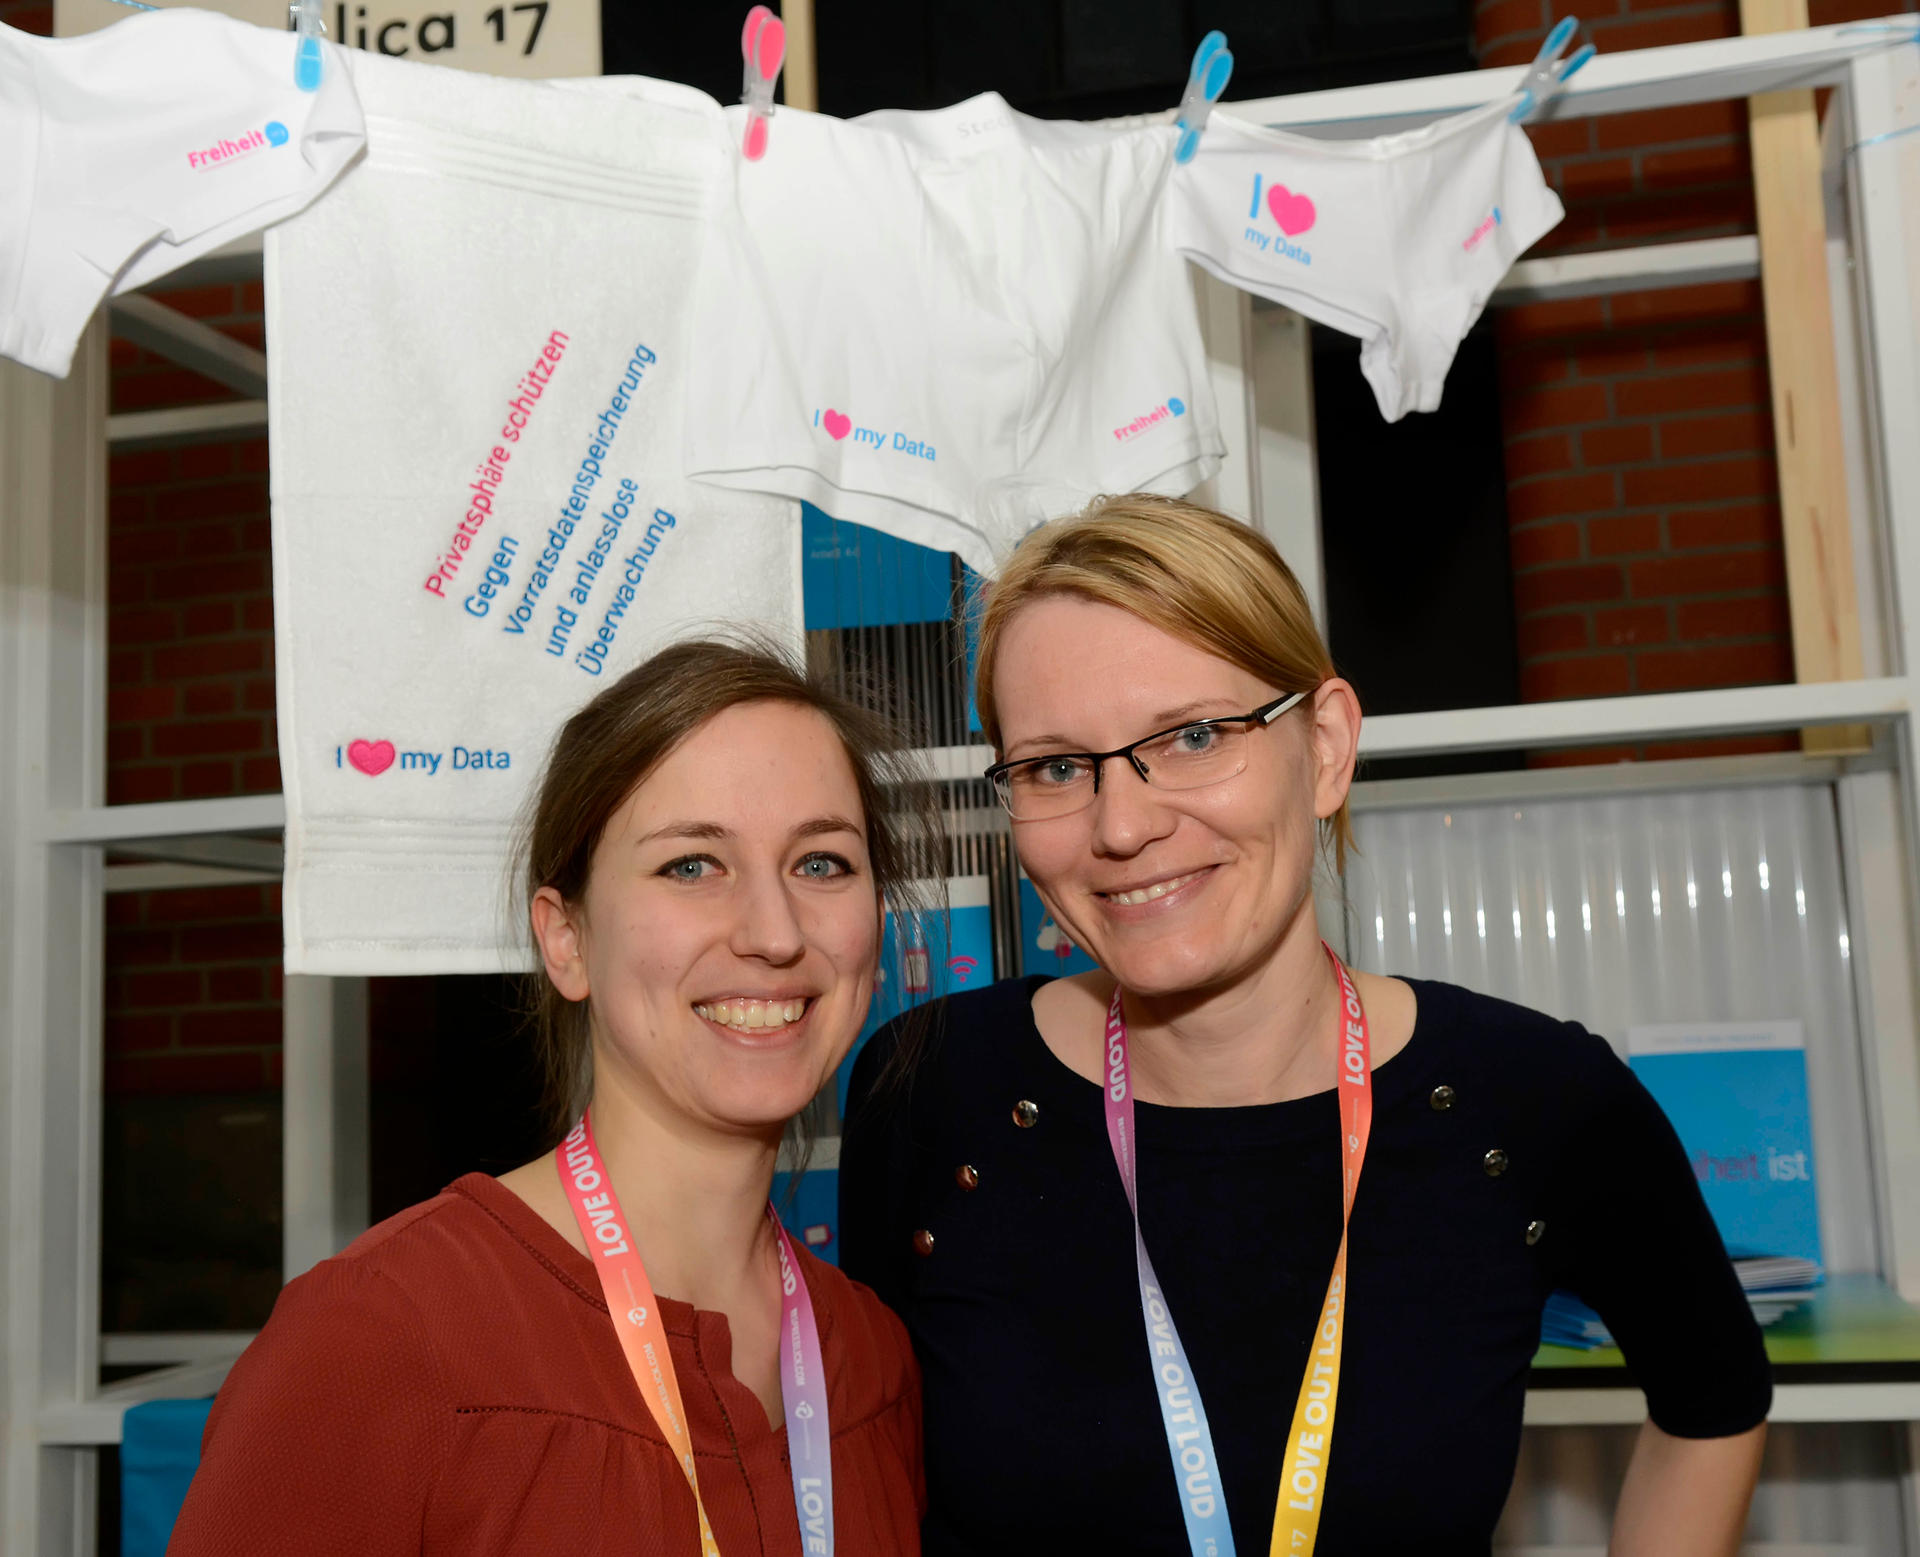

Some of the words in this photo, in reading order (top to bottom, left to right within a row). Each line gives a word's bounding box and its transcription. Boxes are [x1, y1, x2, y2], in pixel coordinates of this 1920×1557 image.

[485, 2, 548, 56] 17
[187, 129, 264, 169] Freiheit
[1249, 173, 1262, 219] I
[1244, 226, 1271, 251] my
[1273, 235, 1312, 266] Data
[813, 408, 820, 428] I
[853, 427, 887, 450] my
[893, 431, 937, 462] Data
[1113, 405, 1169, 441] Freiheit
[423, 445, 511, 599] Privatsphäre
[501, 329, 570, 443] schützen
[503, 343, 658, 636] Vorratsdatenspeicherung
[463, 536, 520, 618] Gegen
[545, 605, 579, 658] und
[569, 477, 640, 606] anlasslose
[576, 507, 677, 676] Überwachung
[336, 746, 342, 769] I
[400, 752, 442, 776] my
[452, 746, 511, 770] Data
[1108, 1031, 1127, 1103] LOUD
[1344, 1020, 1365, 1087] LOVE
[566, 1145, 601, 1192] OUT
[1767, 1147, 1810, 1181] ist
[582, 1191, 629, 1257] LOVE
[776, 1238, 797, 1297] OUD
[1144, 1283, 1177, 1358] LOVE
[1319, 1275, 1342, 1356] LOUD
[1160, 1362, 1198, 1426] OUT
[1304, 1361, 1334, 1426] OUT
[1175, 1430, 1216, 1519] LOUD
[1289, 1431, 1324, 1512] LOVE
[800, 1477, 827, 1555] LOVE
